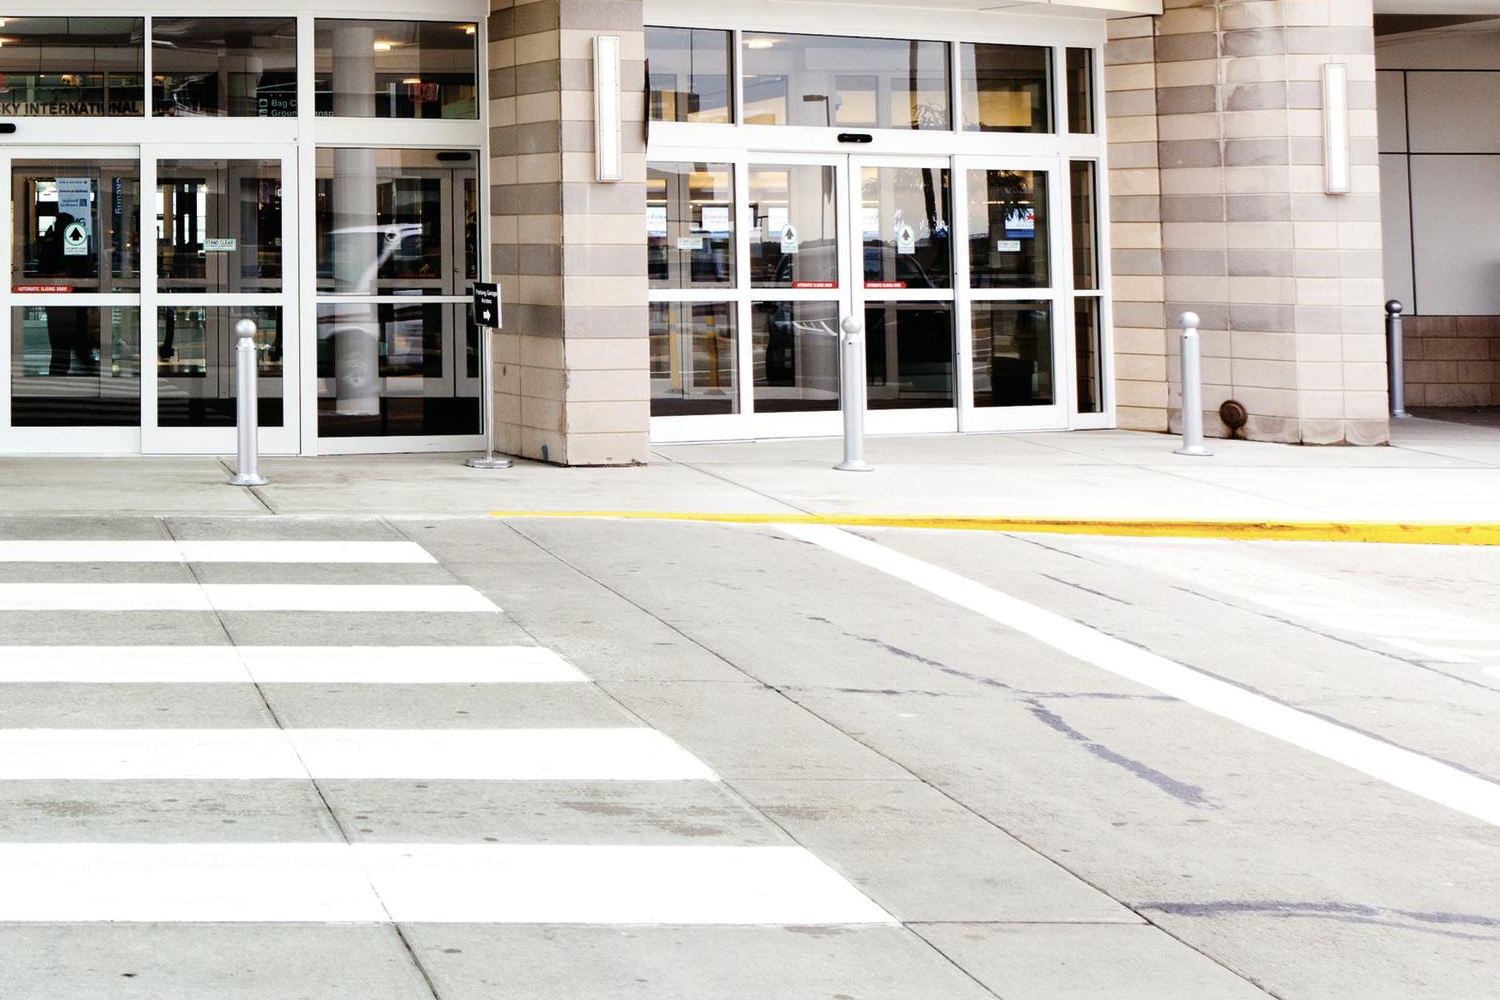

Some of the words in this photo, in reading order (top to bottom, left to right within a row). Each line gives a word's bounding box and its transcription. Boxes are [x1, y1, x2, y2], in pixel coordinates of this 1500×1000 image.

[25, 103, 139, 116] INTERNATIONAL
[271, 100, 288, 110] Bag
[271, 109, 297, 117] Groun
